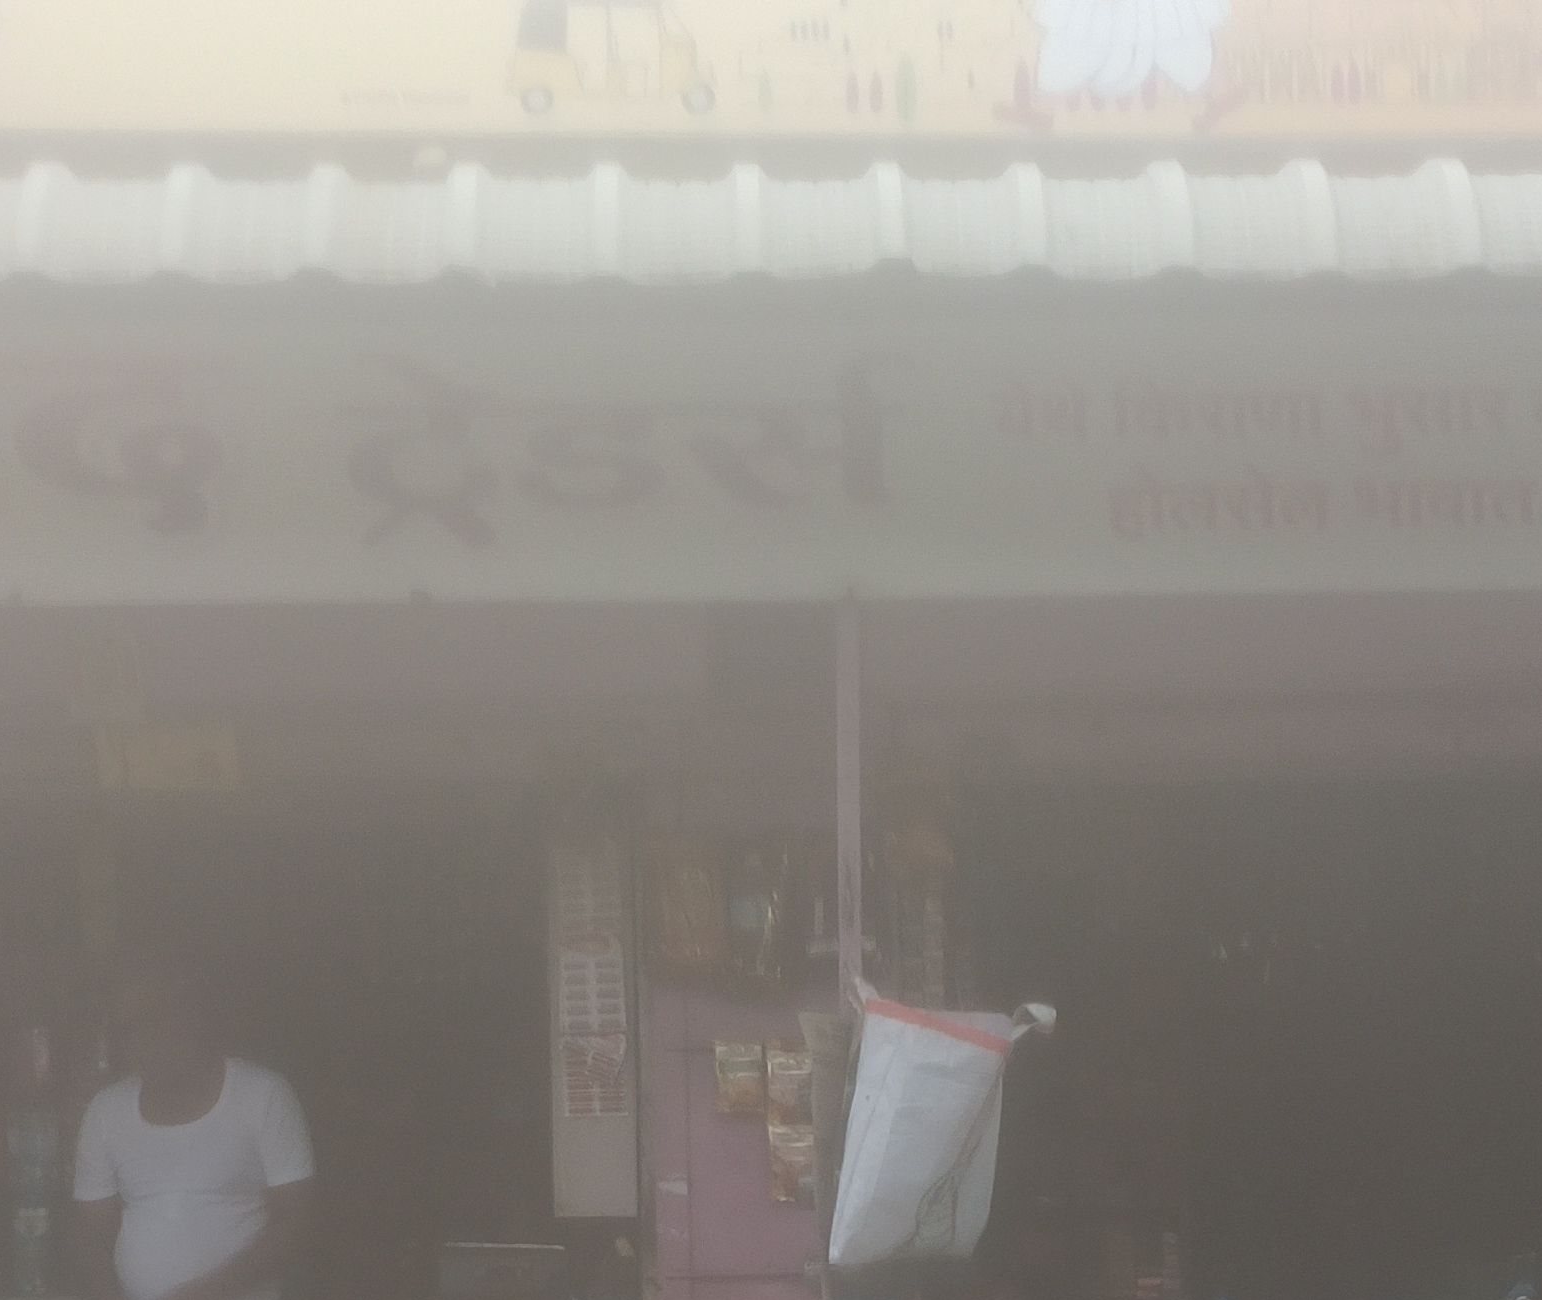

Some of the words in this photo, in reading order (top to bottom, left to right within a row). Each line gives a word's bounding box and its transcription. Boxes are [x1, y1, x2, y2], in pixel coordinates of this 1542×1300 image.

[337, 348, 896, 550] ट्रेडर्स
[1107, 463, 1333, 542] होलसेल
[1353, 474, 1536, 527] भावात
